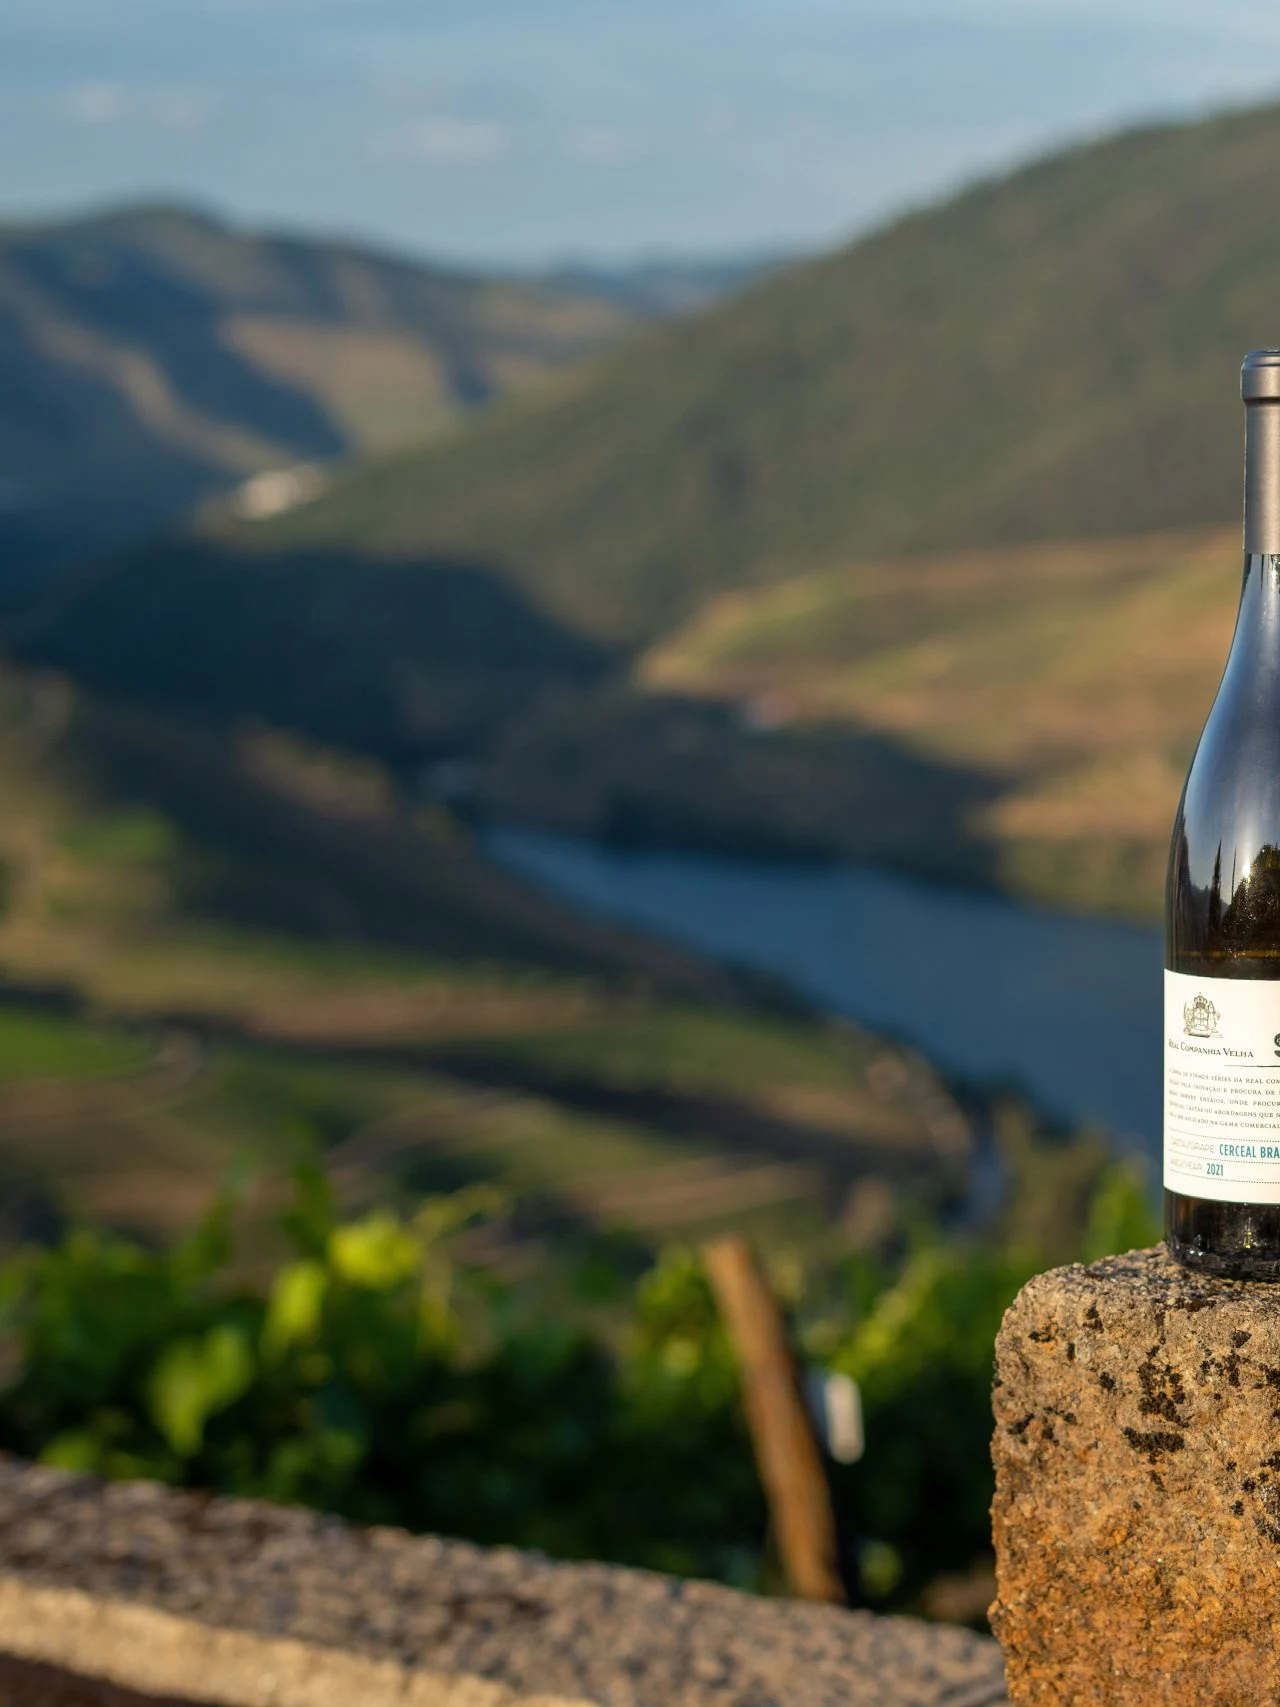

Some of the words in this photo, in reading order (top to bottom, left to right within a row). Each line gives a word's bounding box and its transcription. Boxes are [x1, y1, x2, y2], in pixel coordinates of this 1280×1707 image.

[1180, 1041, 1221, 1056] COMPANHIA
[1223, 1048, 1254, 1058] VELHA
[1214, 1109, 1257, 1117] ABORDAGENS
[1259, 1111, 1274, 1119] QUE
[1219, 1143, 1257, 1158] CERCEAL
[1206, 1163, 1224, 1176] 2021
